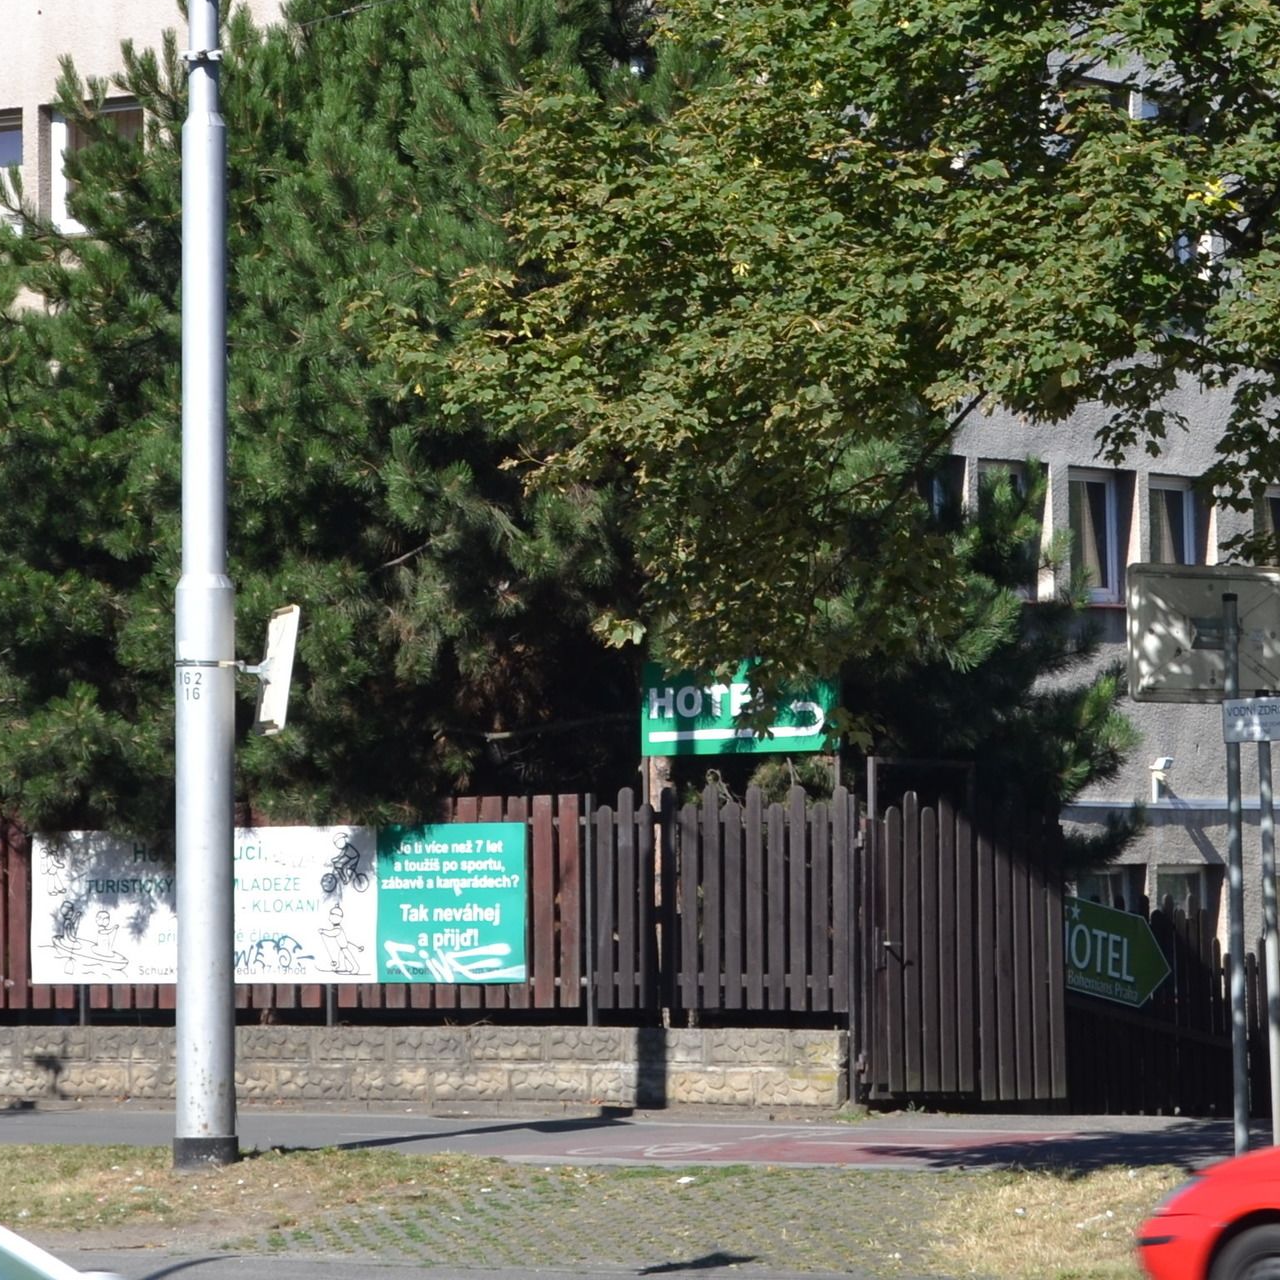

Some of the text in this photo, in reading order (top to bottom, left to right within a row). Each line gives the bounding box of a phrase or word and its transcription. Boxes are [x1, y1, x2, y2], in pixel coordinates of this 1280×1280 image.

[649, 683, 766, 720] HOTE
[425, 841, 449, 854] více
[451, 840, 472, 853] než
[475, 840, 483, 853] 7
[486, 840, 503, 853] let
[394, 861, 401, 872] a
[443, 860, 458, 874] po
[460, 858, 505, 874] sportu,
[381, 876, 424, 889] zábavě
[426, 878, 433, 889] a
[400, 902, 500, 926] Tak neváhej
[418, 933, 428, 946] a
